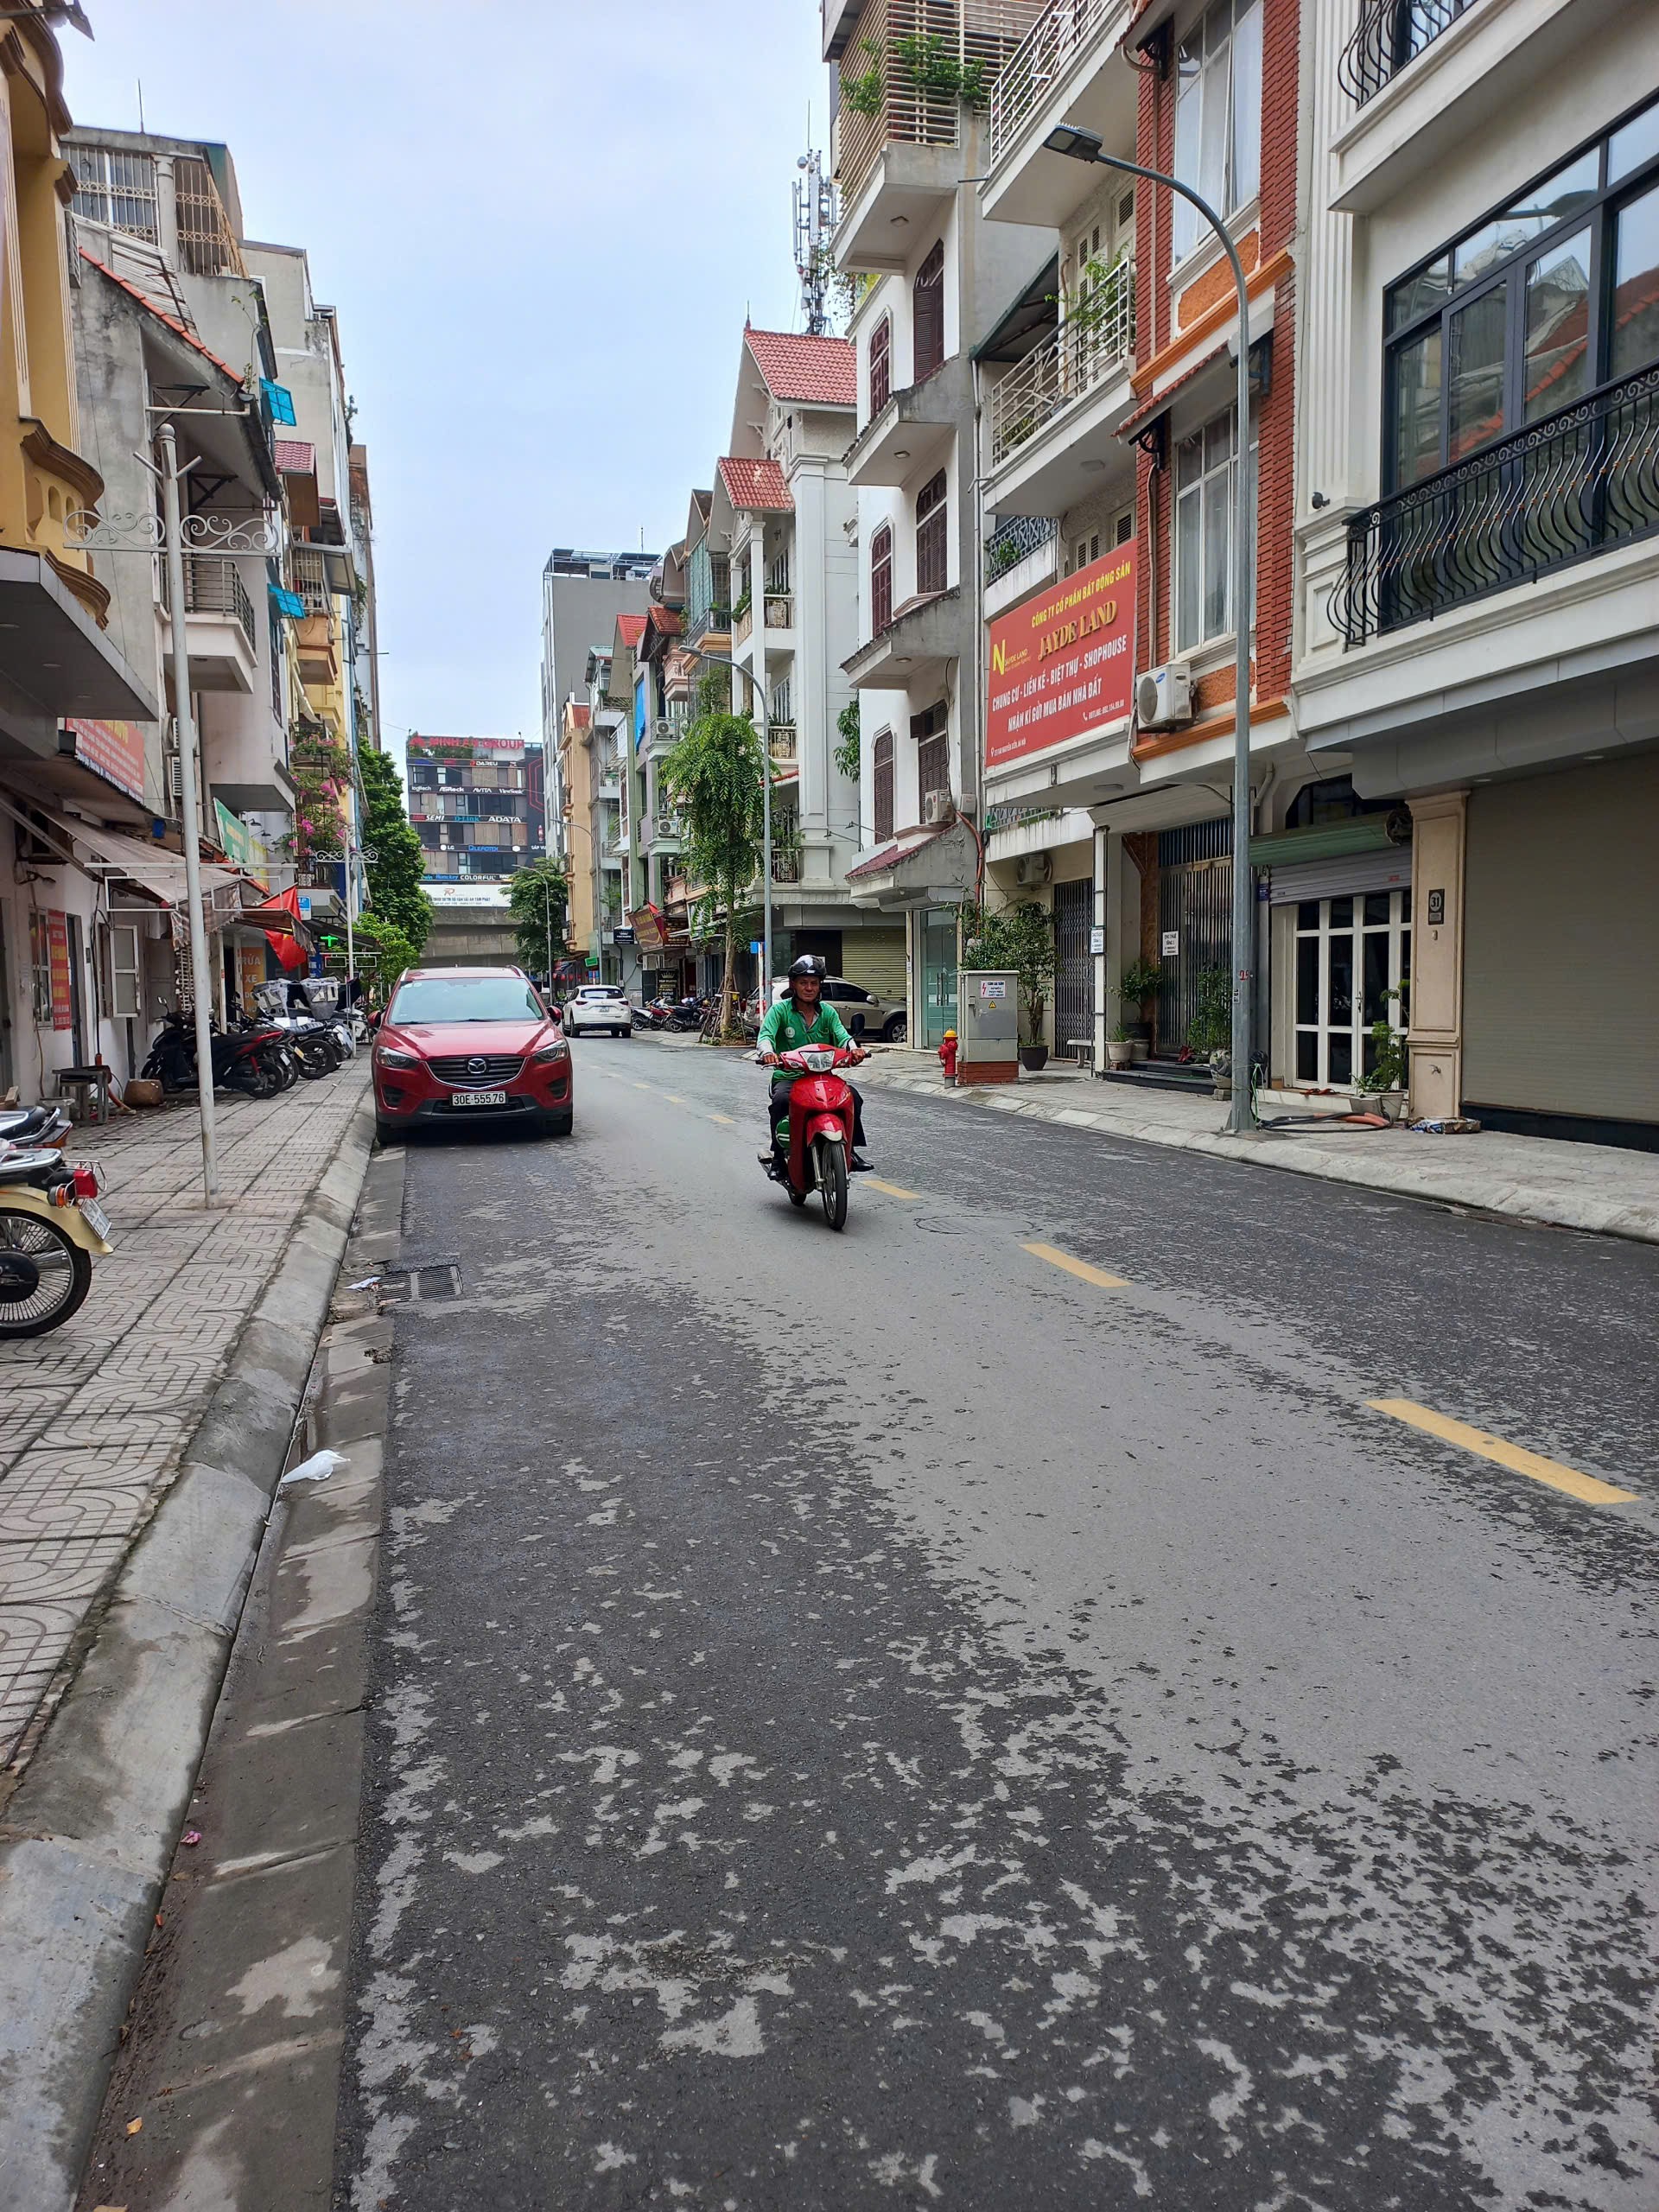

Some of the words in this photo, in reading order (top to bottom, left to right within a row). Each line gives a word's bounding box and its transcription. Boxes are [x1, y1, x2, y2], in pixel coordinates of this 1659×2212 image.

[1048, 604, 1055, 620] TY
[1038, 620, 1077, 662] JAYDE
[1079, 601, 1118, 639] LAND
[993, 692, 1011, 712] CHUNG
[1051, 663, 1065, 686] BIỆT
[1084, 634, 1128, 670] SHOPHOUSE
[1043, 697, 1057, 718] MUA
[1058, 690, 1072, 711] BÁN
[1072, 682, 1087, 705] NHÀ
[429, 735, 458, 747] MINH
[1431, 896, 1440, 907] 31
[242, 953, 261, 965] RỬA
[245, 974, 258, 982] XE
[454, 1093, 505, 1105] 30E-555.76
